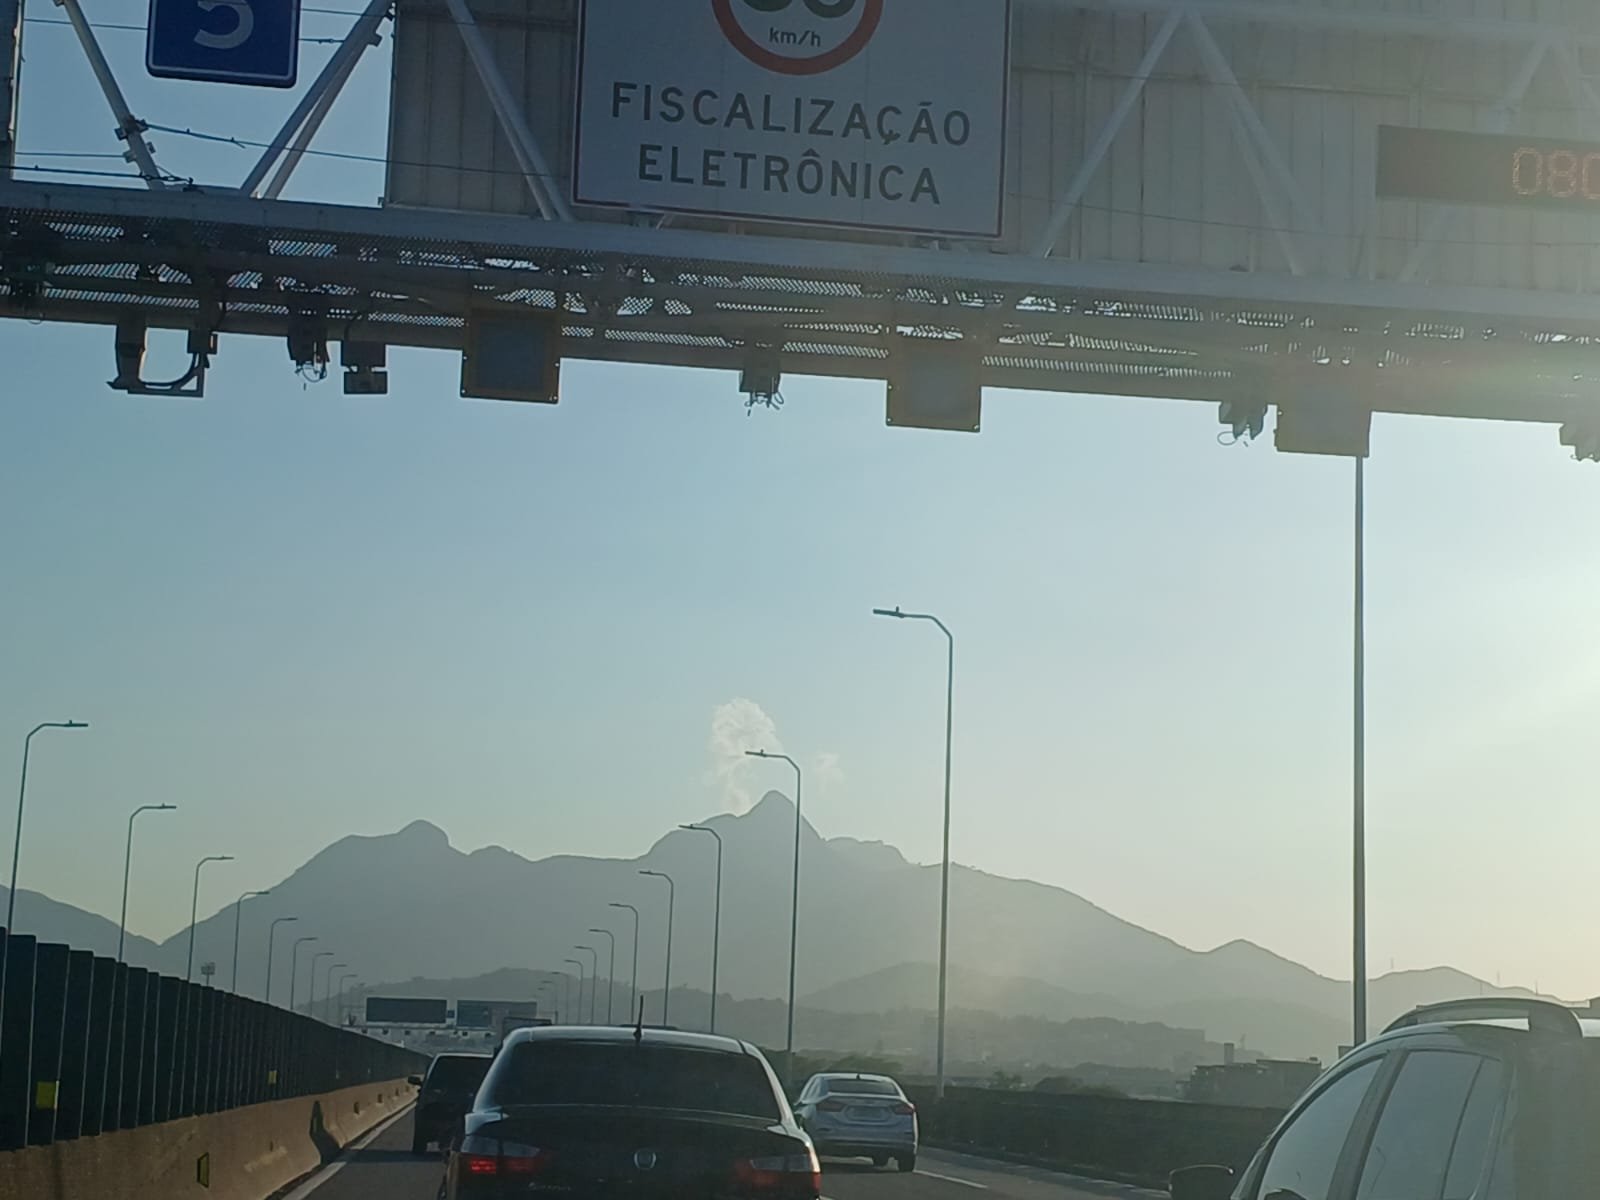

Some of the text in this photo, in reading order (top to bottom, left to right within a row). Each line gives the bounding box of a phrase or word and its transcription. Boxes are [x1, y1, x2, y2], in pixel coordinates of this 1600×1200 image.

[769, 27, 821, 47] km/h
[611, 82, 970, 146] FISCALIZAÇÃO
[638, 144, 940, 205] ELETRÔNICA
